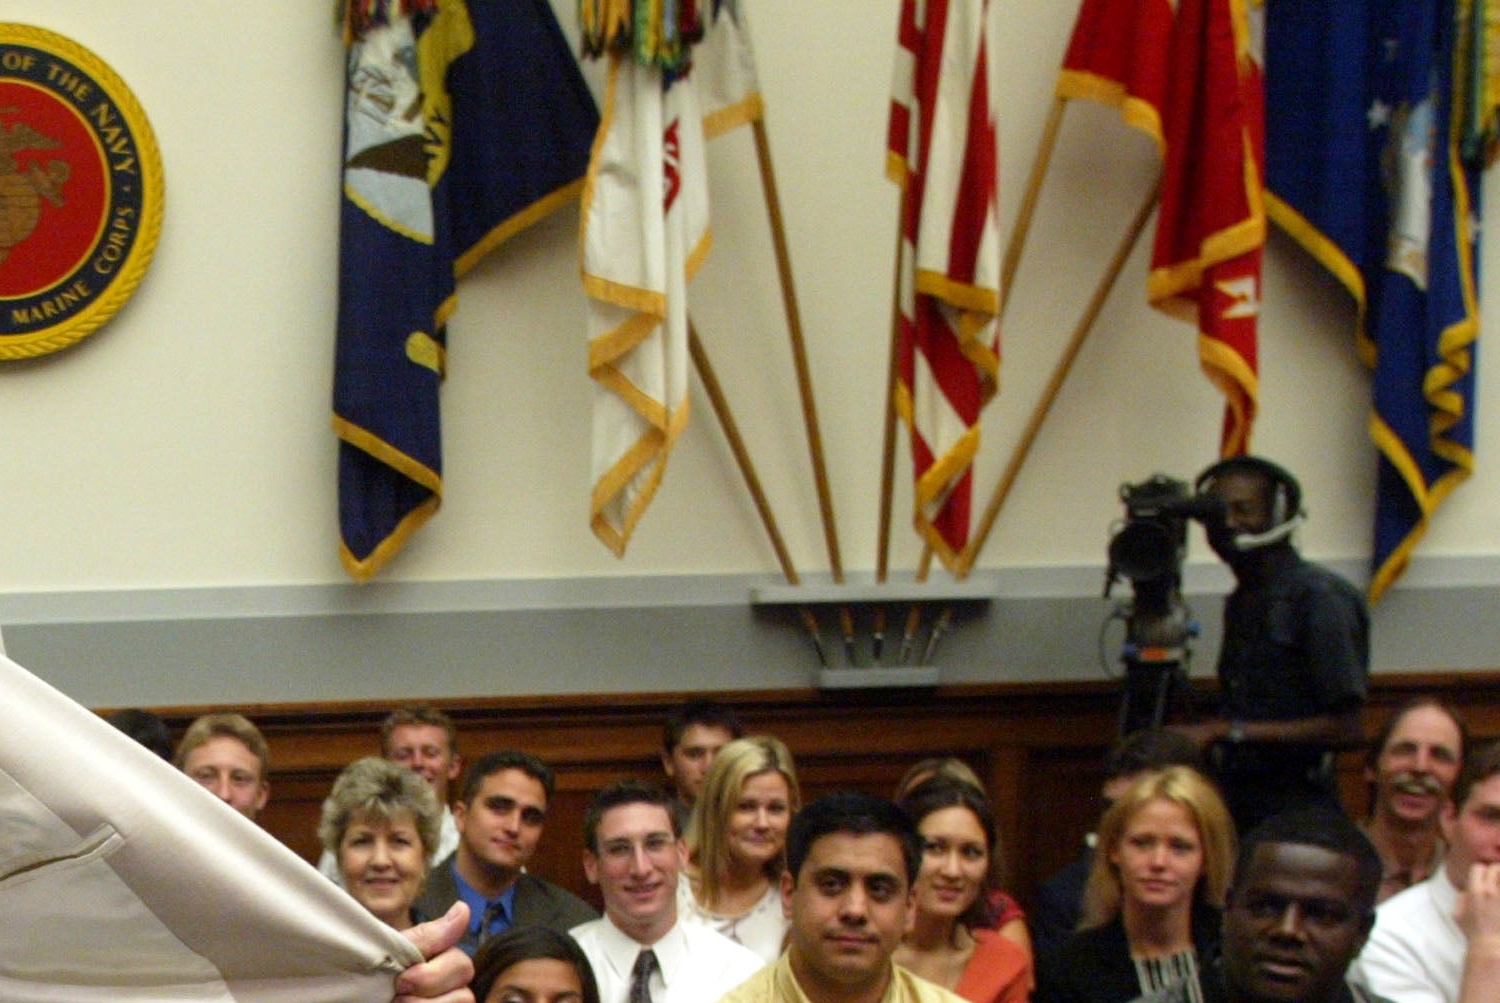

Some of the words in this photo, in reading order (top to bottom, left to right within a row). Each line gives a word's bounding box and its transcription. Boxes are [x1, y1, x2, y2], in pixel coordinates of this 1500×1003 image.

[3, 53, 36, 72] OF
[49, 64, 91, 100] THE
[90, 103, 136, 175] NAVY
[11, 280, 92, 325] MARINE
[93, 205, 135, 275] CORPS
